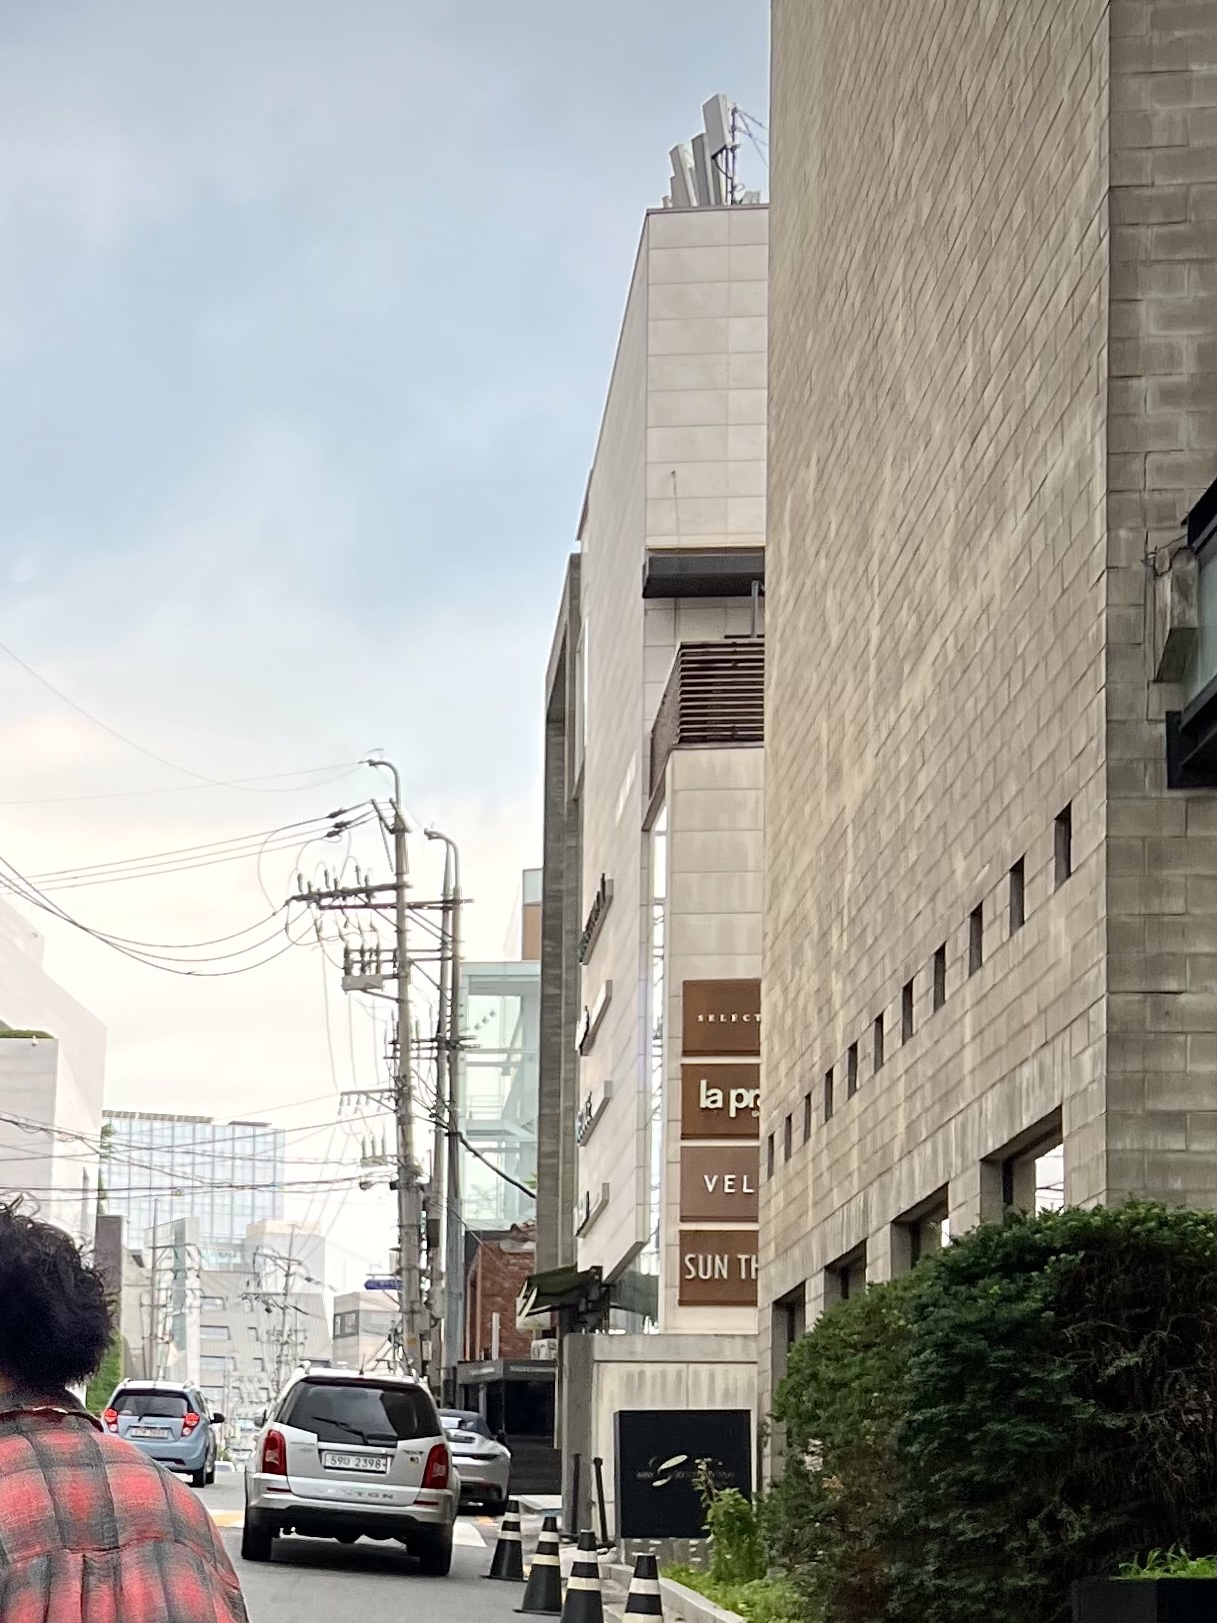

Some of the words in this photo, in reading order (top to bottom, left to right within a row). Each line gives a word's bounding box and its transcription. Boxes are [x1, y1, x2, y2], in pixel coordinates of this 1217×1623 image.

[699, 1079, 724, 1109] la
[728, 1088, 761, 1118] pr
[703, 1174, 755, 1194] VEL
[684, 1253, 729, 1280] SUN
[354, 1457, 382, 1469] 2398
